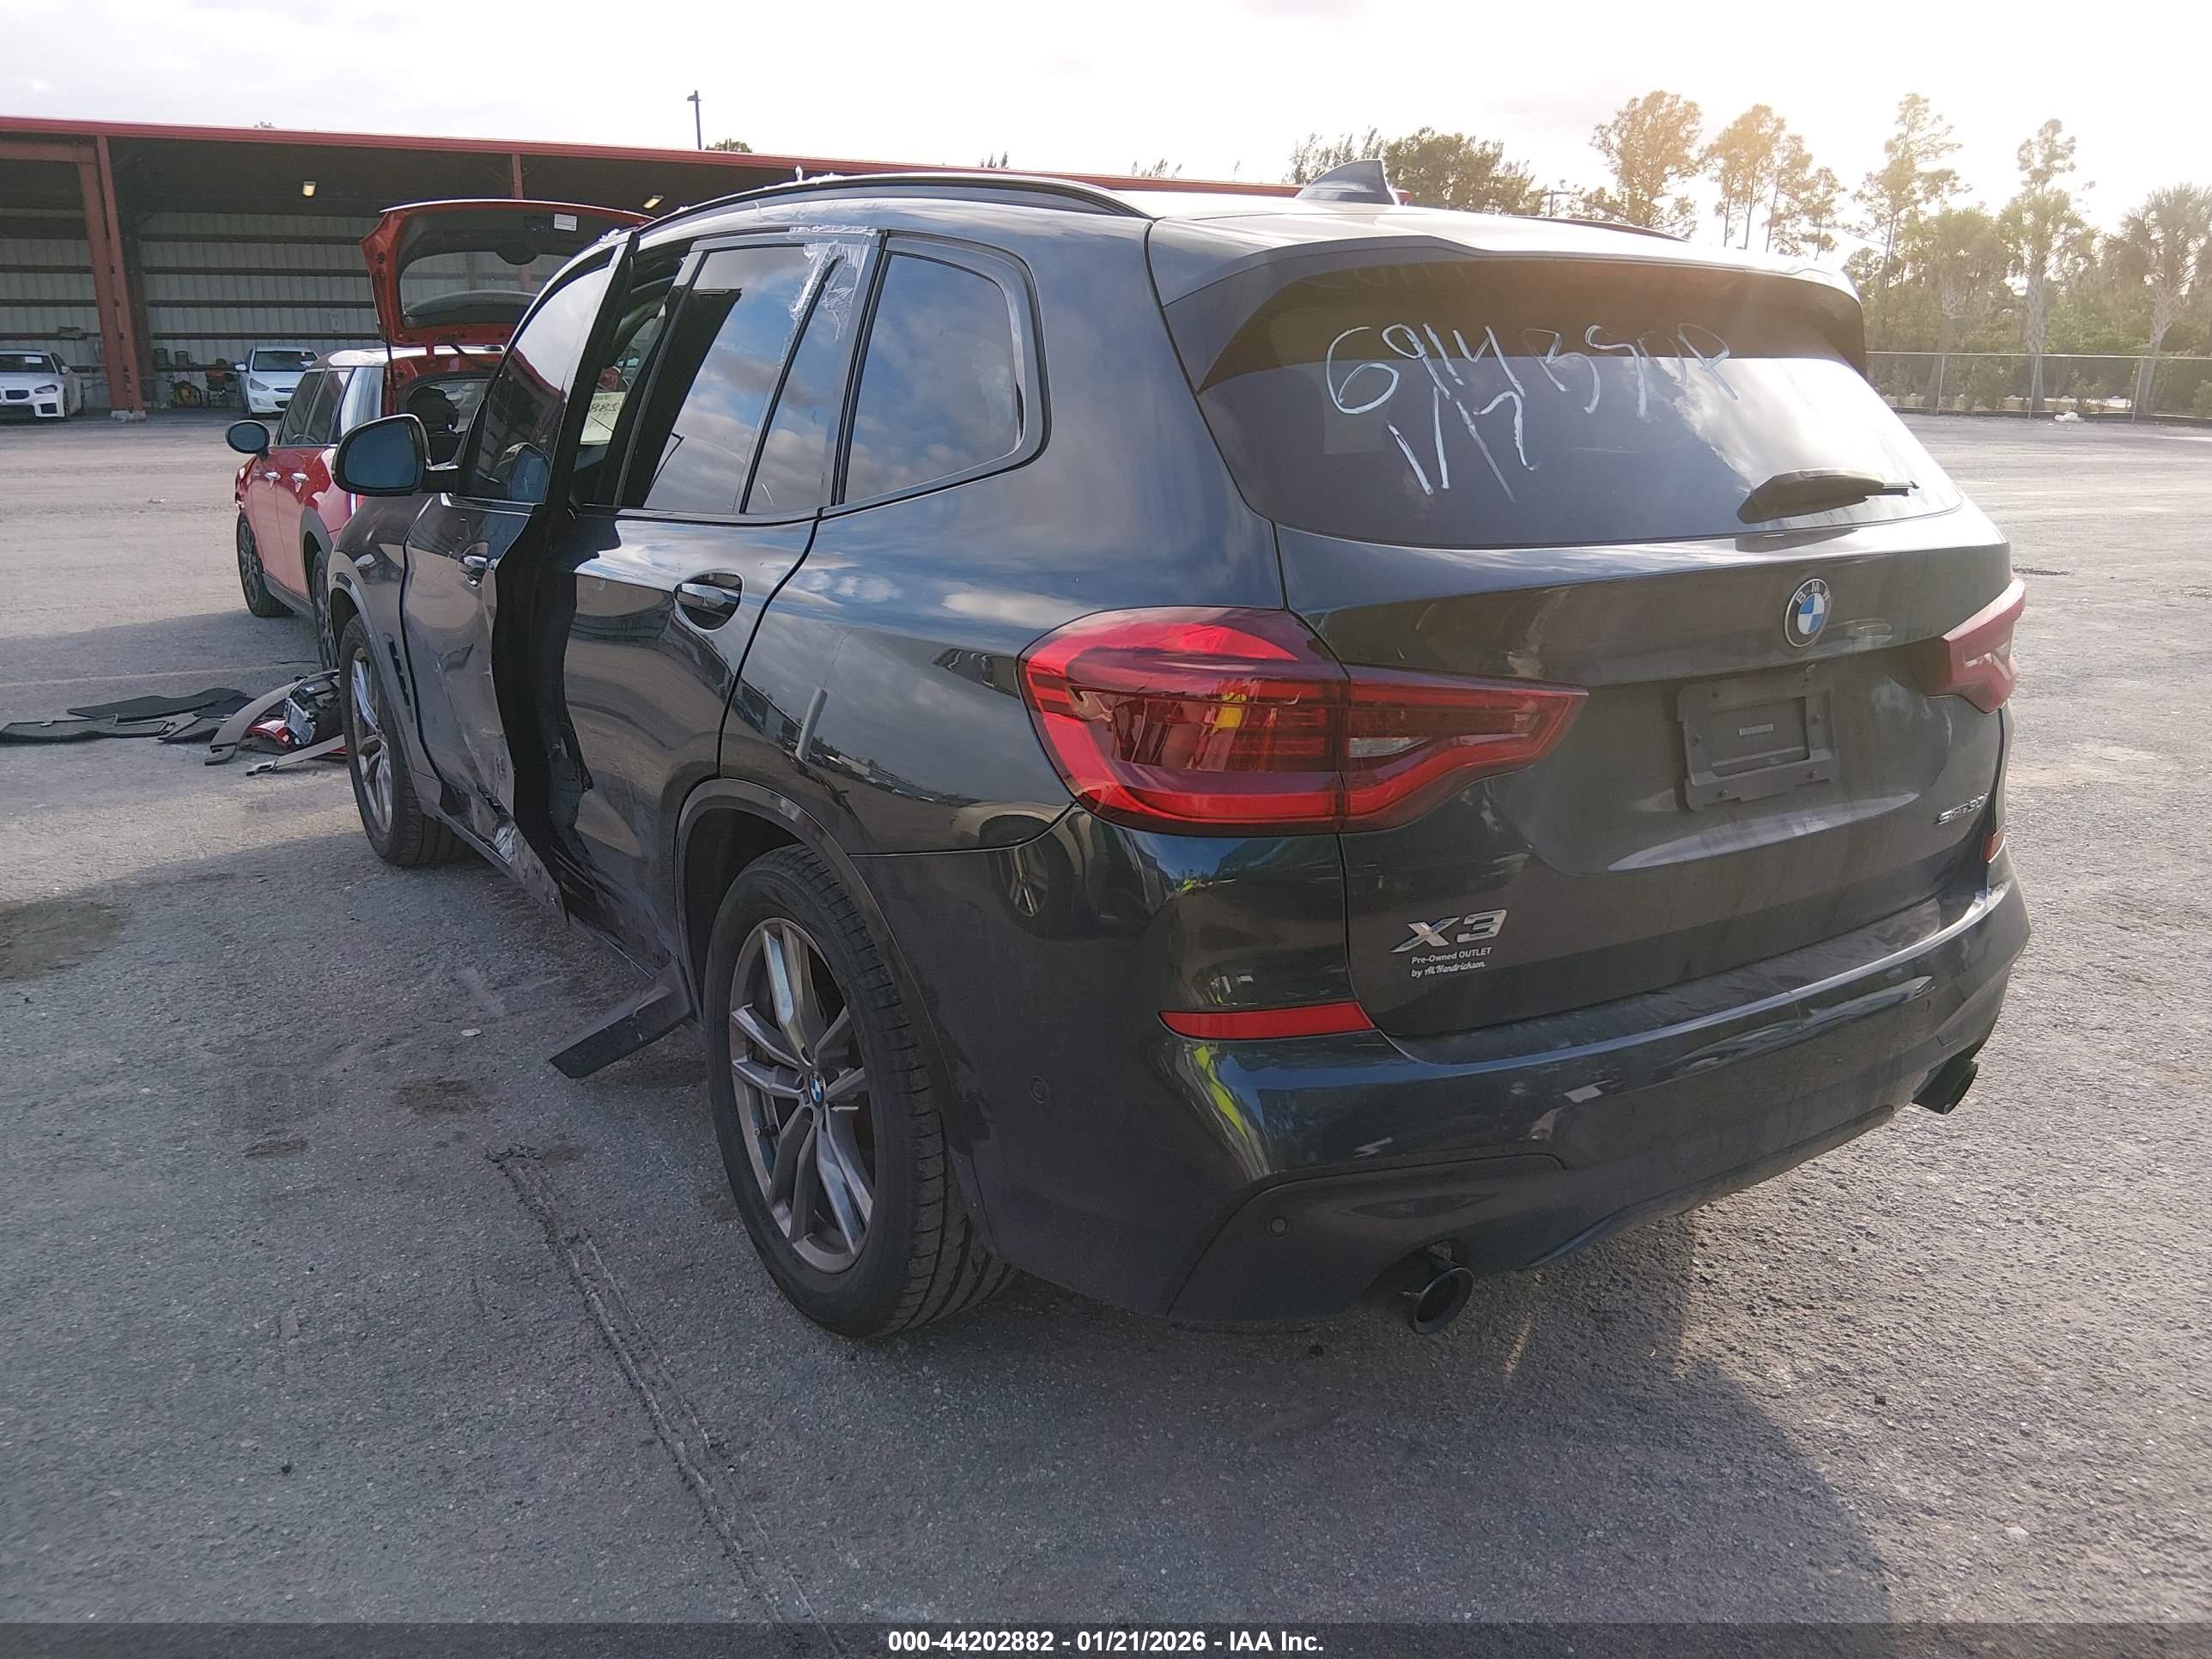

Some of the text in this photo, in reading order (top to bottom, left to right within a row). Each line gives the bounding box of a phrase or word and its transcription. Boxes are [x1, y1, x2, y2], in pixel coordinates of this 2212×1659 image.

[1796, 581, 1831, 605] BMW
[1389, 908, 1508, 953] X3
[1411, 946, 1492, 965] Pre-Owned OUTLET
[1411, 965, 1423, 979] by
